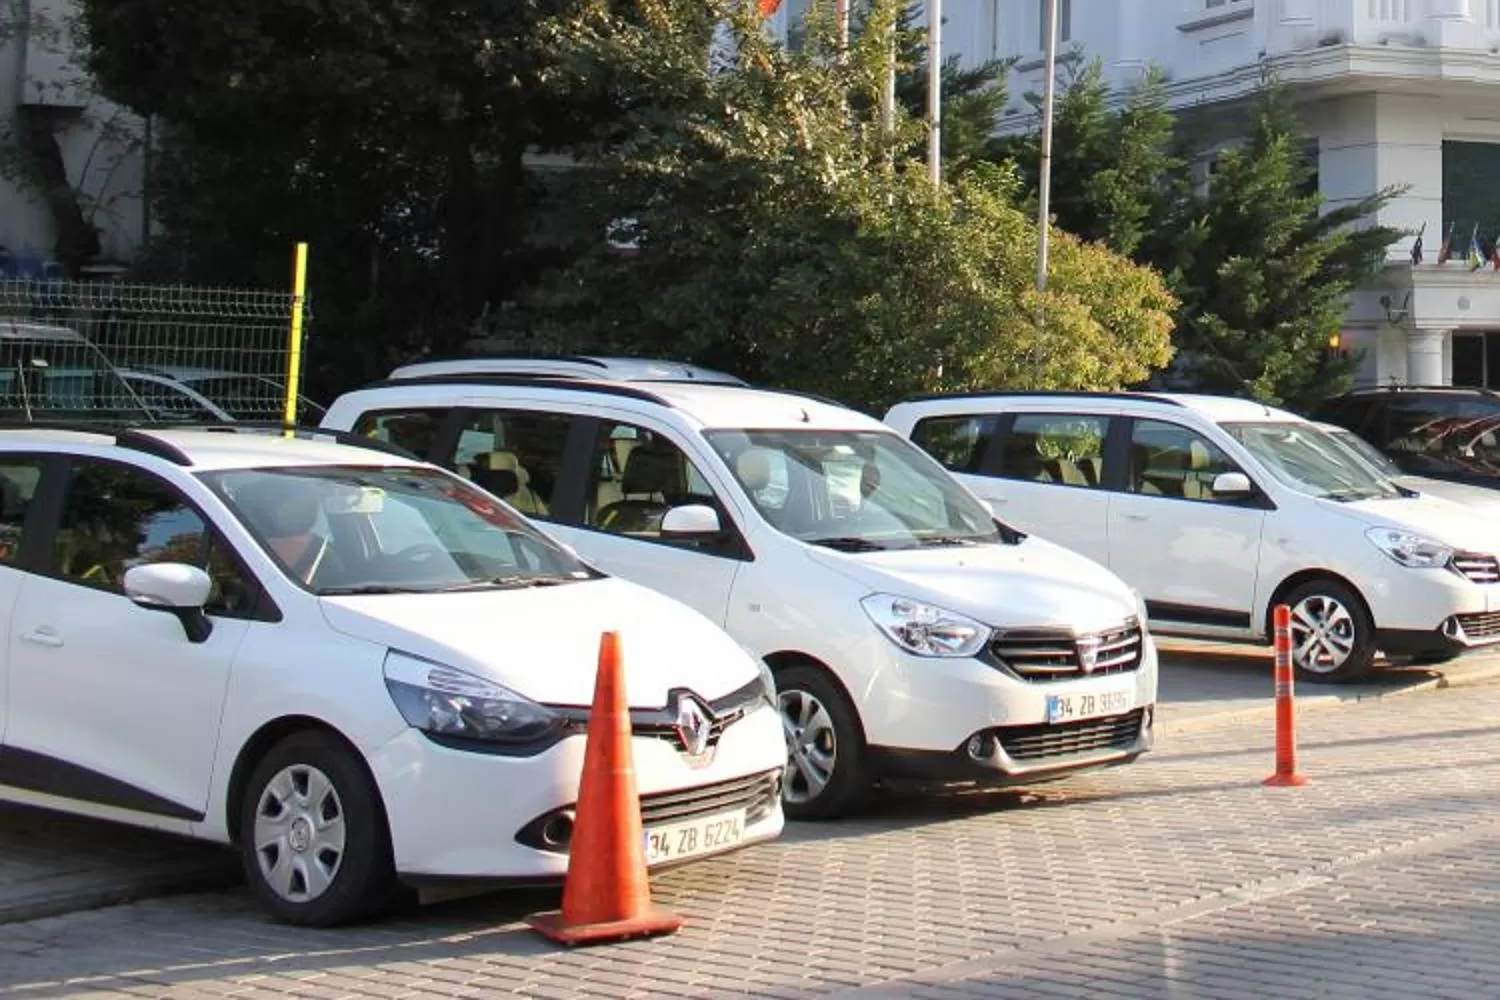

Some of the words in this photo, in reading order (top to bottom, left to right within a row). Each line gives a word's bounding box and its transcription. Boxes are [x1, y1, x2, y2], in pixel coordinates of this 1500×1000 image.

[1059, 696, 1073, 718] 34
[1080, 695, 1095, 716] ZB
[650, 831, 671, 859] 34
[678, 827, 698, 854] ZB
[704, 817, 740, 848] 6224
